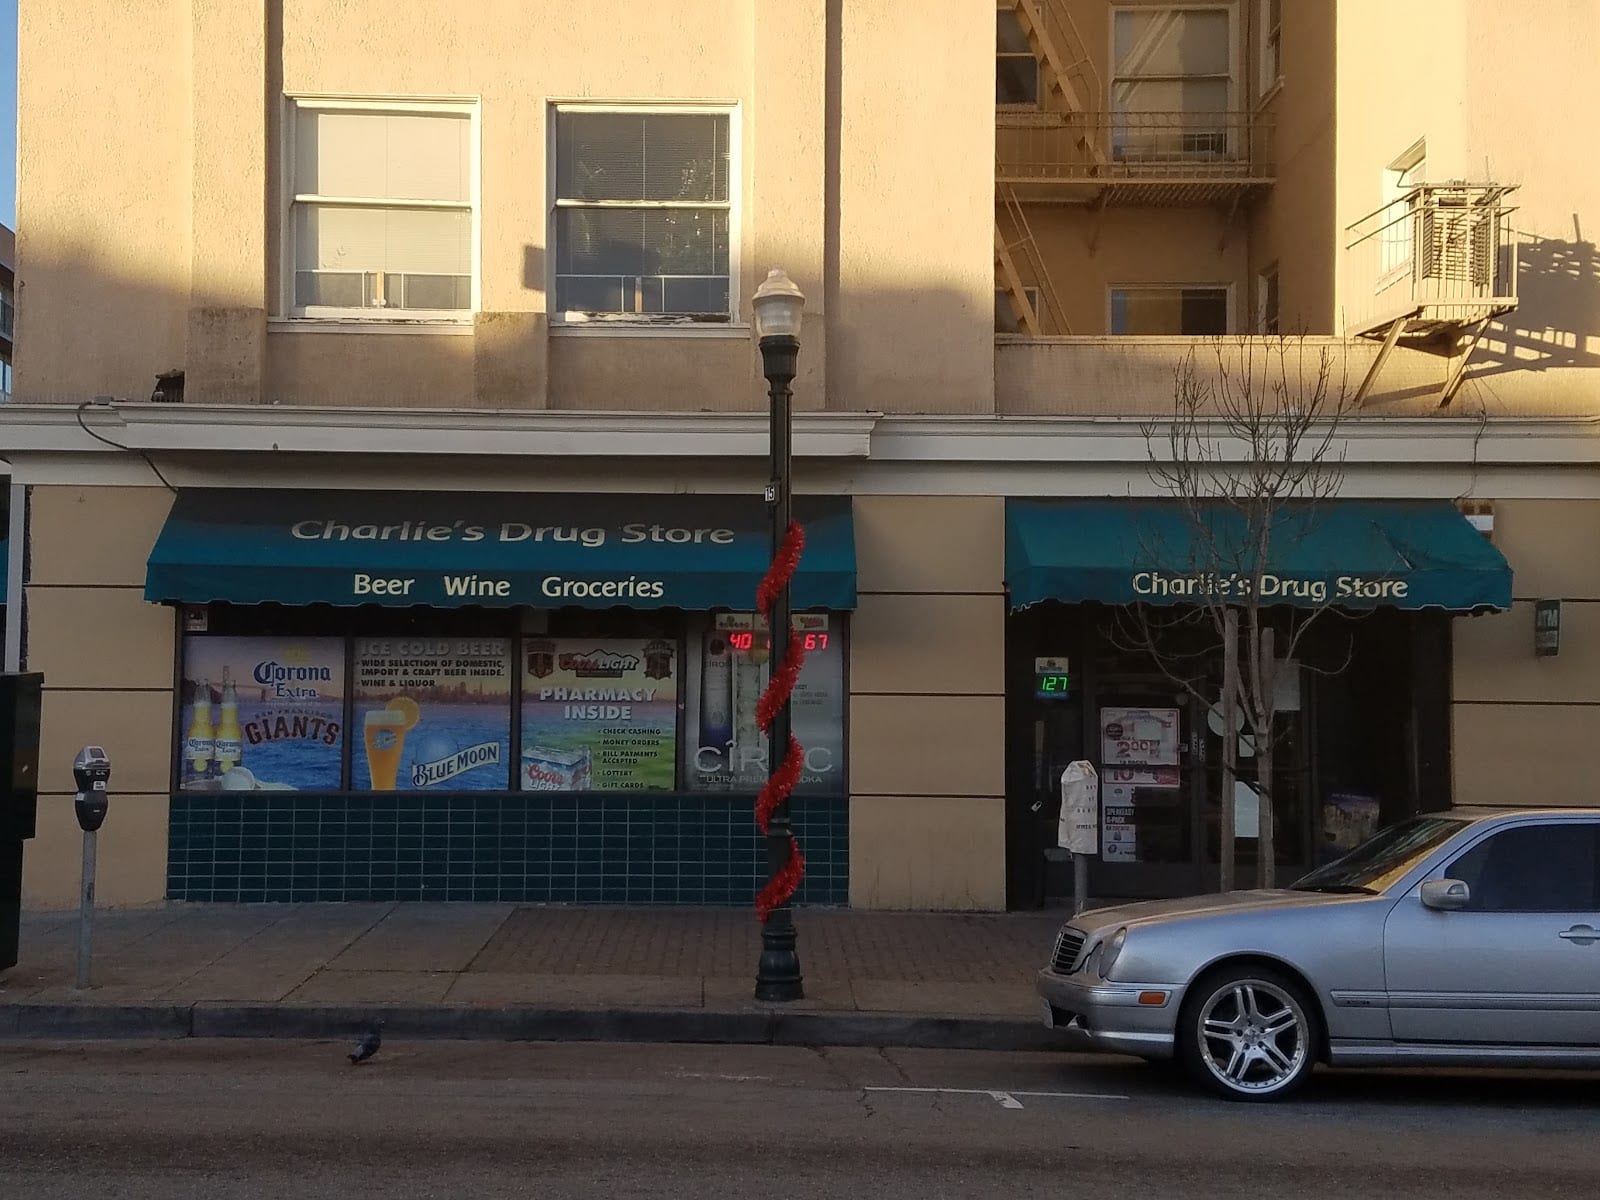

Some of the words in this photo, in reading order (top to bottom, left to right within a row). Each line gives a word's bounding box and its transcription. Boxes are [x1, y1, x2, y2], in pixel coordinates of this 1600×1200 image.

[764, 486, 775, 501] 15
[291, 519, 485, 541] Charlie's
[498, 522, 606, 547] Drug
[620, 522, 735, 544] Store
[353, 573, 416, 596] Beer
[443, 574, 512, 597] Wine
[541, 574, 664, 598] Groceries
[1132, 571, 1252, 597] Charlie's
[1259, 574, 1327, 602] Drug
[1335, 576, 1409, 599] Store
[360, 640, 391, 656] ICE
[398, 640, 450, 656] COLD
[456, 640, 505, 657] BEER
[803, 633, 829, 650] 67
[361, 659, 386, 667] WIDE
[388, 659, 437, 667] SELECTION
[598, 658, 637, 670] LIGHT
[253, 661, 332, 687] Corona
[361, 668, 398, 676] IMPORT
[1042, 676, 1068, 691] 127
[539, 687, 657, 702] PHARMACY
[564, 704, 633, 720] INSIDE
[244, 715, 340, 745] GIANTS
[412, 759, 454, 787] BLUE
[456, 745, 498, 771] MOON
